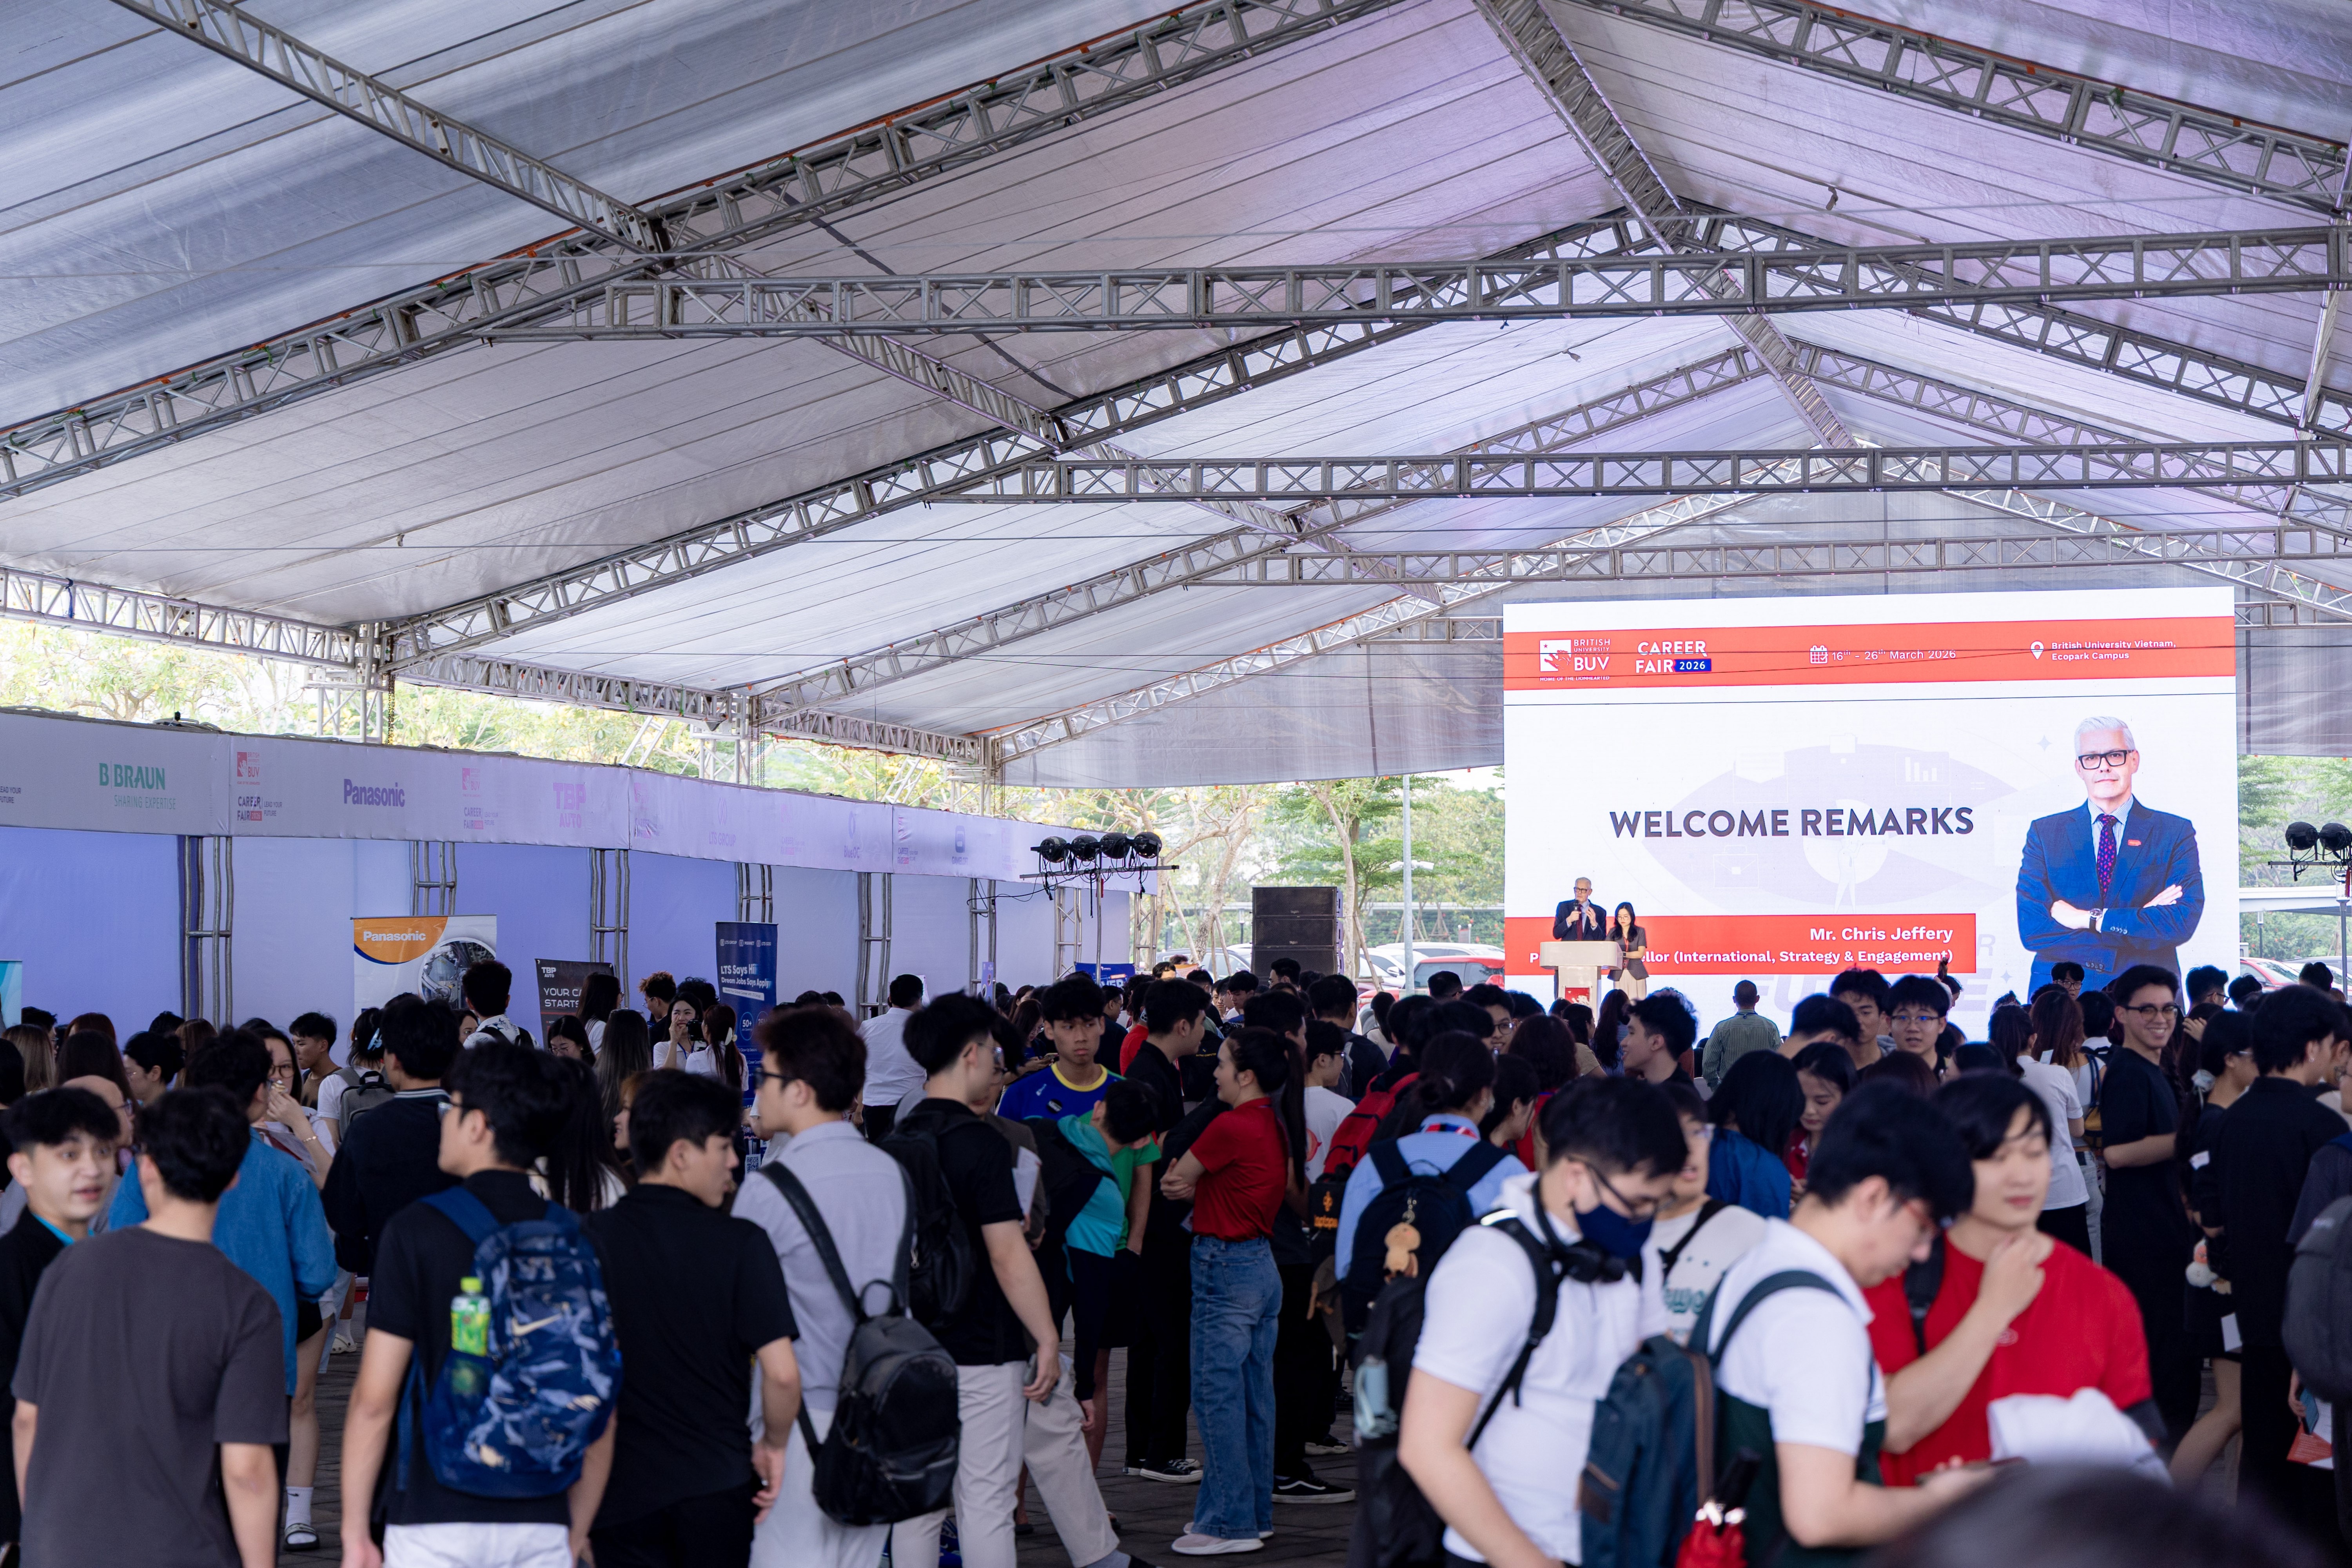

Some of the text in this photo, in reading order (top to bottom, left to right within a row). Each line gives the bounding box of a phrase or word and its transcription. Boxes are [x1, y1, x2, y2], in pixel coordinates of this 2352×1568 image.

[1637, 641, 1708, 657] CAREER
[2085, 641, 2132, 649] University
[2134, 640, 2176, 648] Vietnam,
[1890, 650, 1924, 659] March
[1929, 650, 1956, 659] 2026
[2052, 652, 2129, 661] Ecopark Campus
[1574, 657, 1610, 671] BUV
[1636, 659, 1706, 673] FAIR 2026
[99, 763, 165, 790] B BRAUN
[248, 766, 260, 777] BUV
[344, 779, 405, 808] Panasonic
[553, 782, 586, 810] TBP
[114, 795, 176, 810] SHARING EXPERTISE
[238, 797, 261, 809] CAREER
[237, 810, 250, 821] FAIR
[464, 807, 483, 819] CAREER
[464, 820, 474, 829] FAIR
[559, 813, 582, 828] AUTO
[1610, 807, 1974, 838] WELCOME REMARKS
[718, 833, 736, 847] GROUP
[844, 846, 860, 858] BlueOC
[363, 931, 426, 941] Panasonic
[1810, 926, 1953, 943] Mr. Chris Jeffery
[1674, 951, 1775, 964] (International,
[1779, 950, 1840, 965] Strategy
[1844, 951, 1854, 962] &
[1858, 949, 1953, 965] Engagement)
[721, 965, 731, 974] LTS
[733, 965, 747, 976] Says
[747, 978, 756, 987] Says
[757, 978, 769, 989] Apply
[544, 988, 570, 996] YOUR
[544, 999, 579, 1007] STARTS
